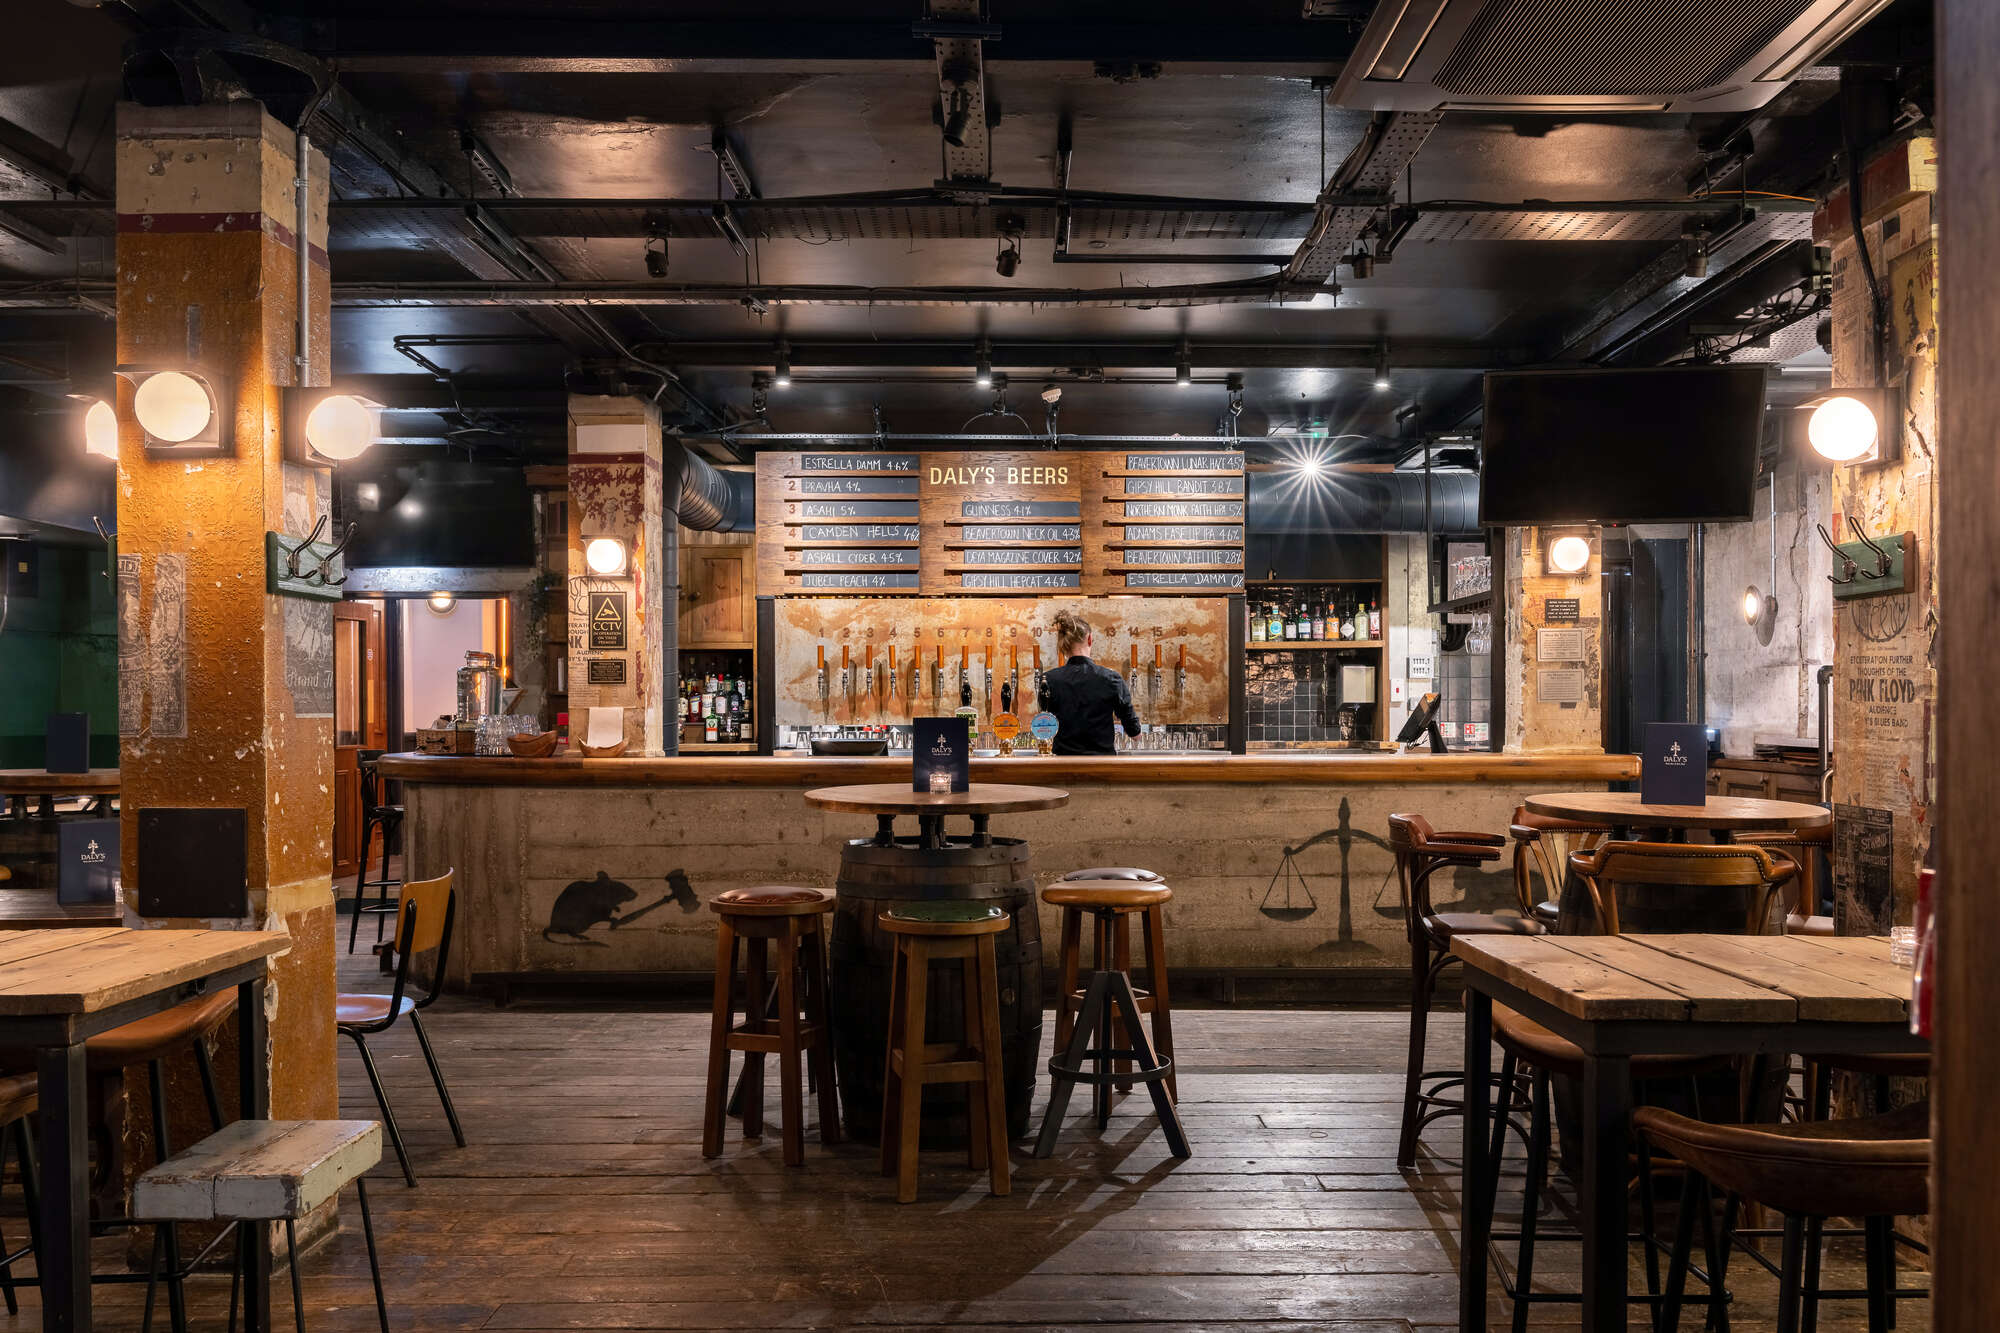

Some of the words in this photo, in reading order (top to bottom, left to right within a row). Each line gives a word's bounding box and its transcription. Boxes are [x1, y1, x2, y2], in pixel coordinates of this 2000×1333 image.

[805, 457, 853, 470] ESTRELLA
[856, 459, 881, 470] DAMM
[1128, 456, 1180, 470] BEAVERTOWN
[930, 466, 995, 485] DALY'S
[1007, 466, 1069, 485] BEERS
[788, 480, 796, 491] 2
[805, 480, 841, 492] PRAVHA
[846, 481, 861, 492] 4%
[1127, 480, 1152, 493] GIPSY
[1155, 480, 1171, 493] HILL
[1177, 480, 1208, 493] BANDIT
[789, 504, 796, 514] 3
[806, 506, 836, 517] ASAHI
[840, 506, 855, 516] 5%
[965, 504, 1011, 516] GUINNESS
[1127, 503, 1165, 516] NORTHERN
[1167, 503, 1188, 516] MONK
[788, 528, 796, 538] 4
[808, 526, 858, 538] CAMDEN
[867, 525, 899, 538] HELLS
[965, 527, 1019, 540] BEAVERTOWN
[1022, 527, 1045, 540] NECK
[1127, 527, 1161, 540] ADNAMS
[1203, 528, 1215, 540] IPA
[806, 552, 841, 563] ASPALL
[847, 552, 878, 563] CYDER
[988, 551, 1029, 563] MAGAZINE
[1032, 551, 1060, 563] COVER
[1127, 551, 1180, 564] BEAVERTOWN
[1183, 551, 1222, 564] SATELLITE
[806, 575, 834, 587] JUBEL
[839, 575, 867, 587] PEACH
[872, 575, 886, 587] 4%
[964, 575, 987, 587] GIPSY
[989, 575, 1005, 587] HILL
[1010, 575, 1042, 587] HEPCAT
[1128, 574, 1188, 585] ESTRELLA
[1194, 573, 1226, 585] DAMM
[592, 621, 622, 631] CCTV
[819, 627, 824, 638] 1
[843, 627, 850, 638] 2
[867, 627, 874, 638] 3
[889, 627, 897, 638] 4
[914, 627, 921, 638] 5
[937, 627, 944, 638] 6
[962, 627, 969, 638] 7
[986, 627, 992, 638] 8
[1010, 627, 1016, 638] 9
[1031, 627, 1042, 638] 10
[1104, 627, 1116, 638] 13
[1127, 627, 1139, 638] 14
[1151, 627, 1163, 638] 15
[1176, 627, 1188, 638] 16
[1889, 655, 1913, 664] FURTHER
[1857, 667, 1886, 676] THOUGHTS
[1886, 667, 1894, 676] OF
[1896, 667, 1907, 677] THE
[1849, 678, 1875, 702] PINK
[1879, 678, 1915, 703] FLOYD
[1868, 705, 1897, 715] AUDIENCE
[1892, 718, 1908, 728] BAND
